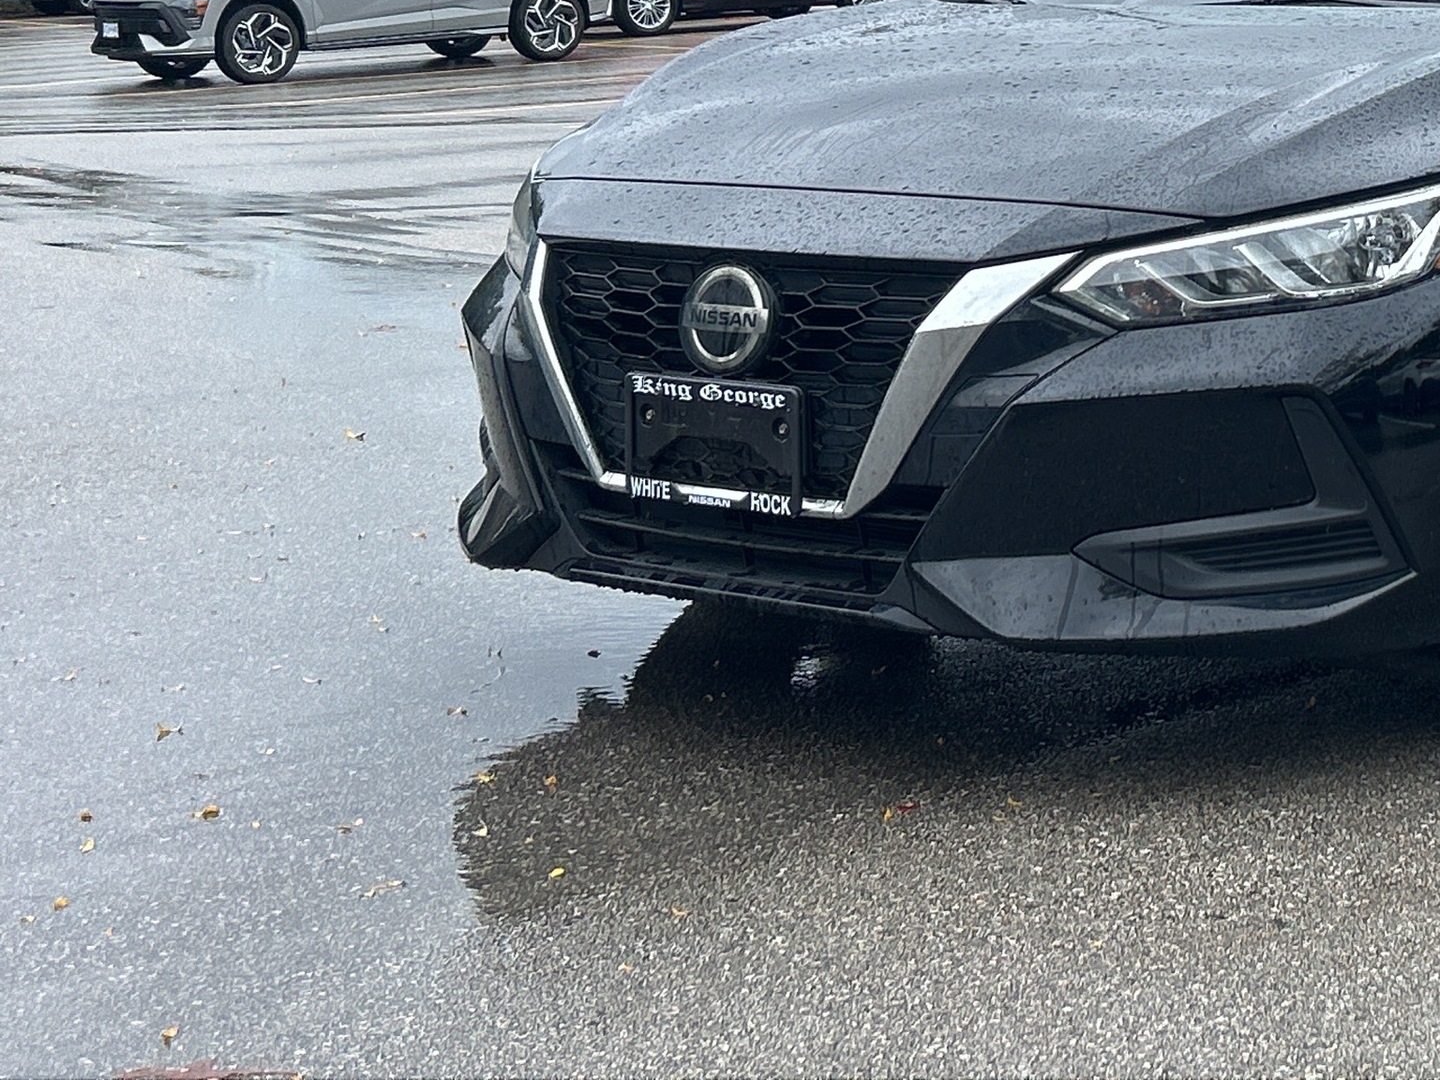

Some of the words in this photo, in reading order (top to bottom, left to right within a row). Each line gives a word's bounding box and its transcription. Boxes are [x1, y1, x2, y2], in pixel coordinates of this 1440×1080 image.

[689, 309, 757, 328] NISSAN
[632, 376, 693, 401] King
[699, 384, 786, 409] George
[630, 476, 671, 499] WHITE
[688, 495, 731, 508] NISSAN
[750, 492, 791, 515] ROCK
